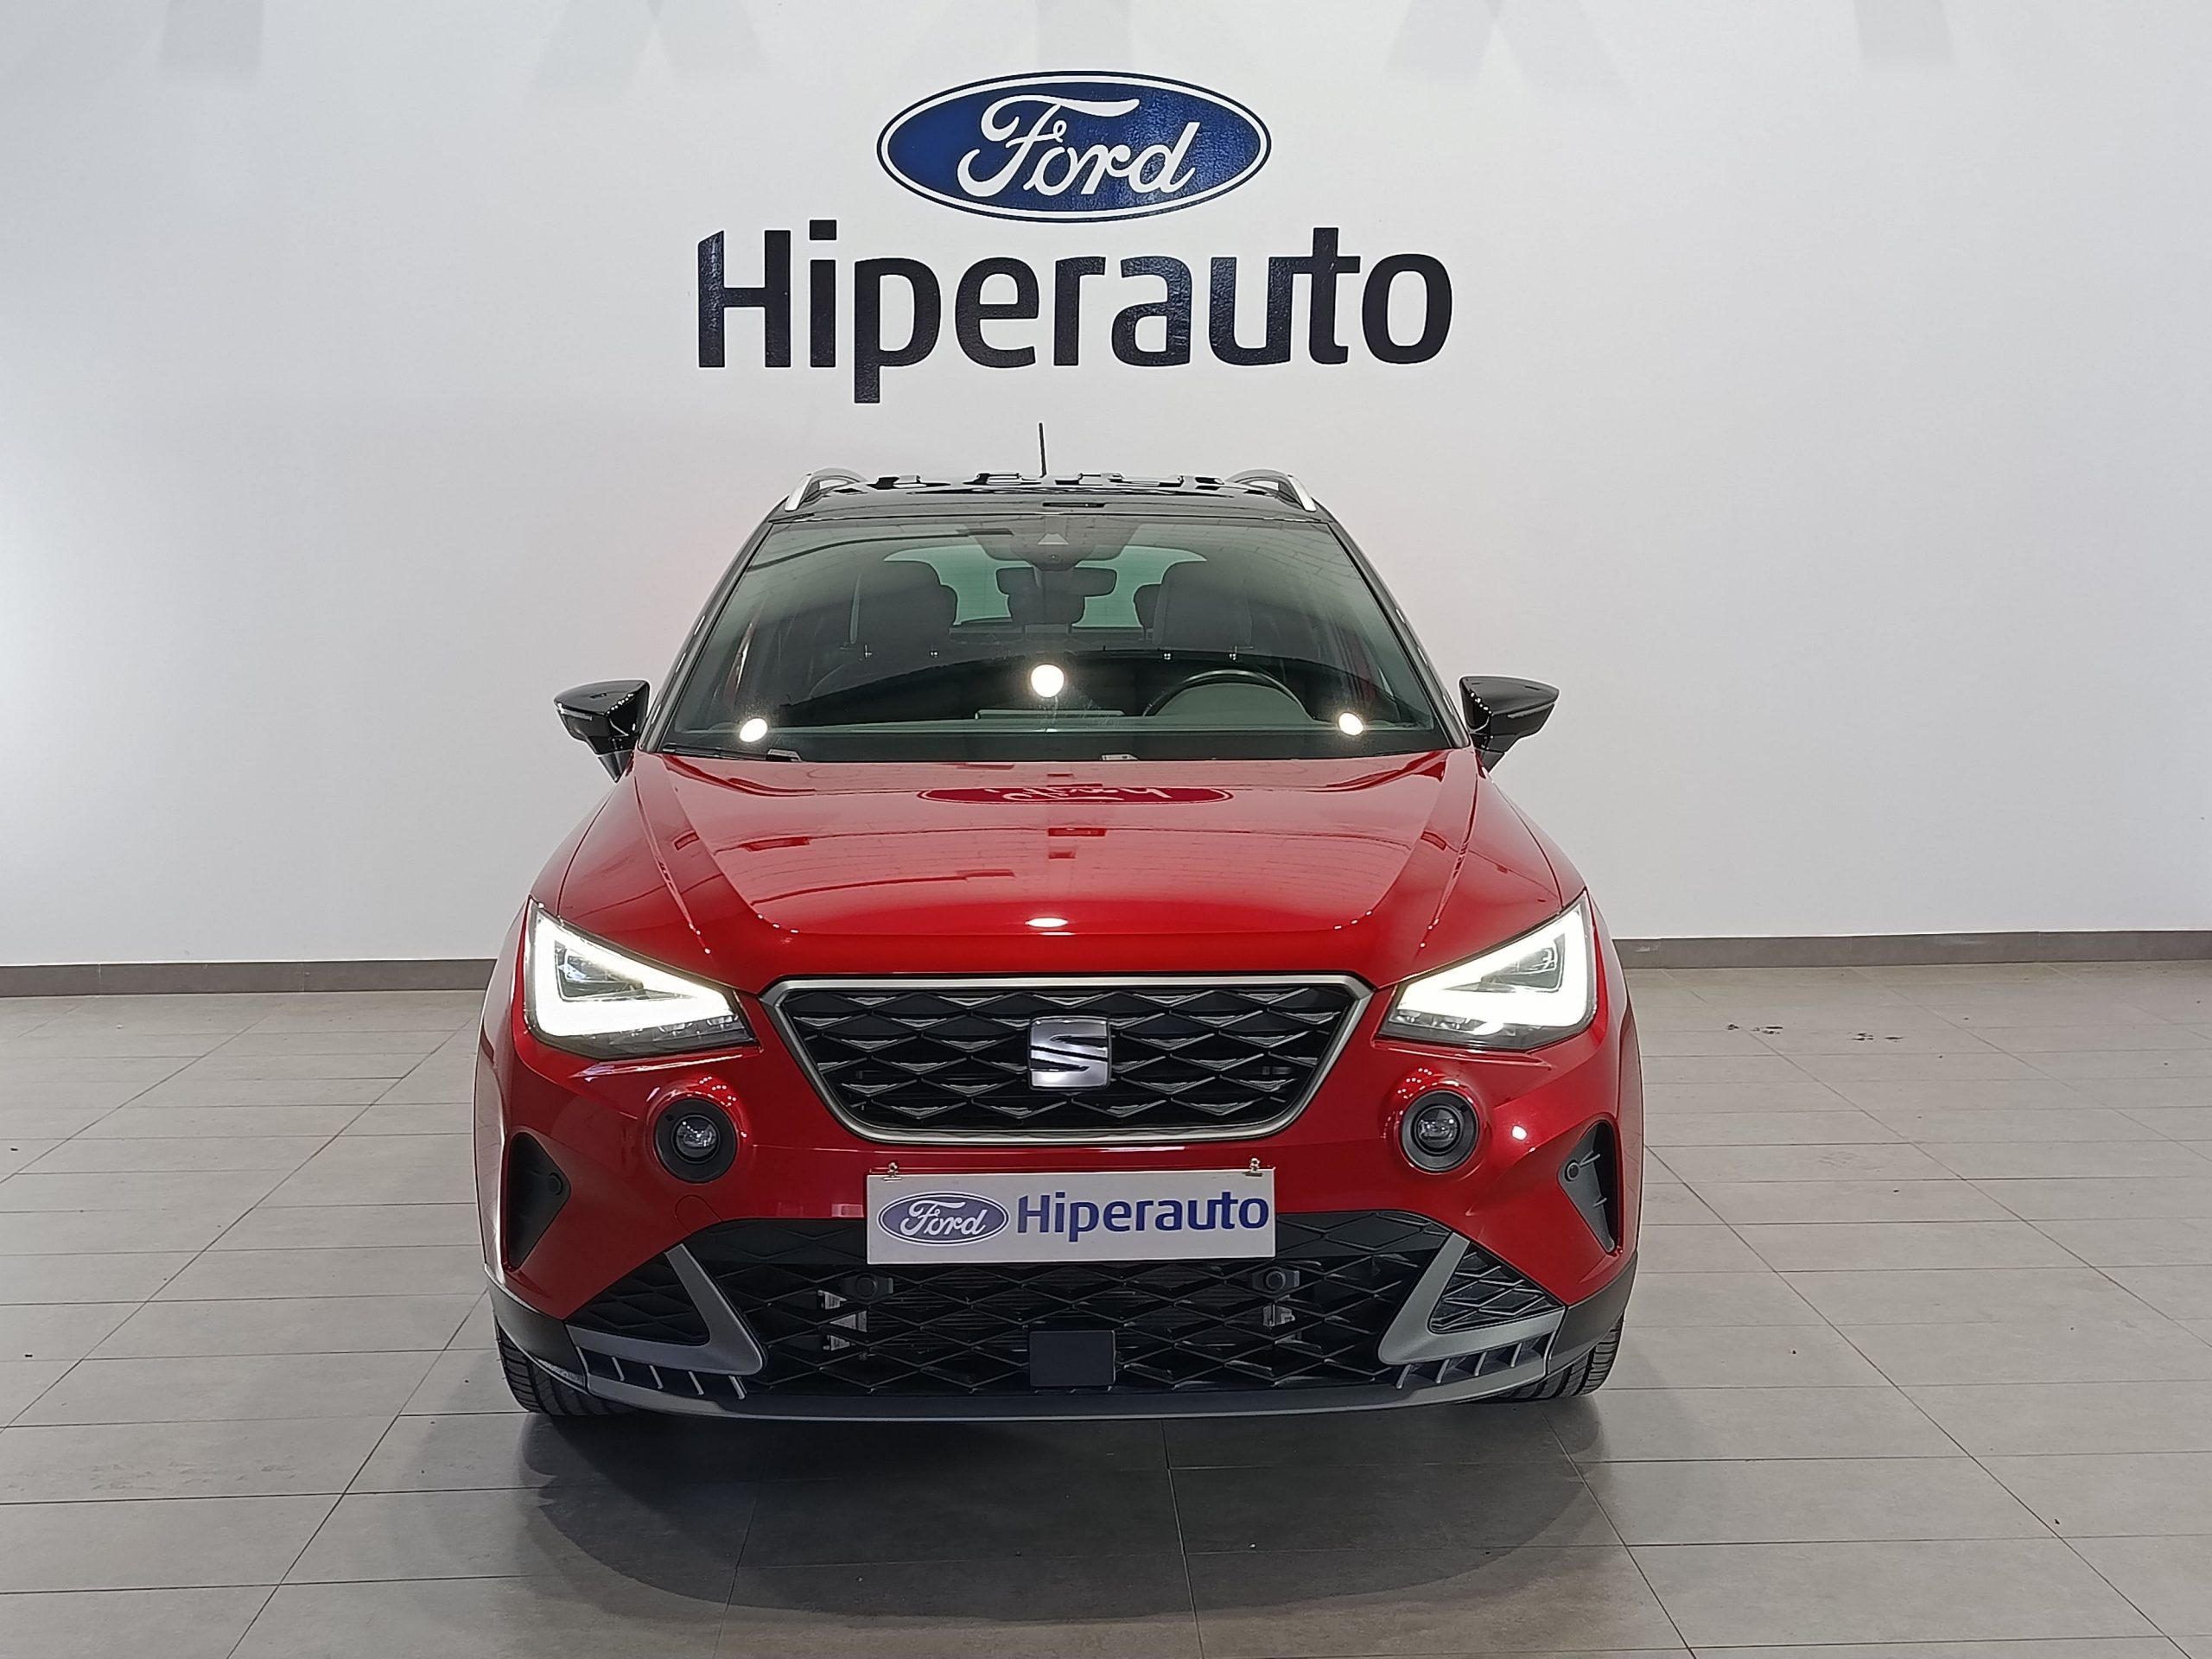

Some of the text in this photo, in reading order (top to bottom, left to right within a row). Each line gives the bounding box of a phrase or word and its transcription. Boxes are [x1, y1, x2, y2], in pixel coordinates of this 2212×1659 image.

[957, 94, 1201, 197] Ford
[696, 219, 1453, 404] Hiperauto
[899, 1190, 1270, 1243] Ford Hiperauto
